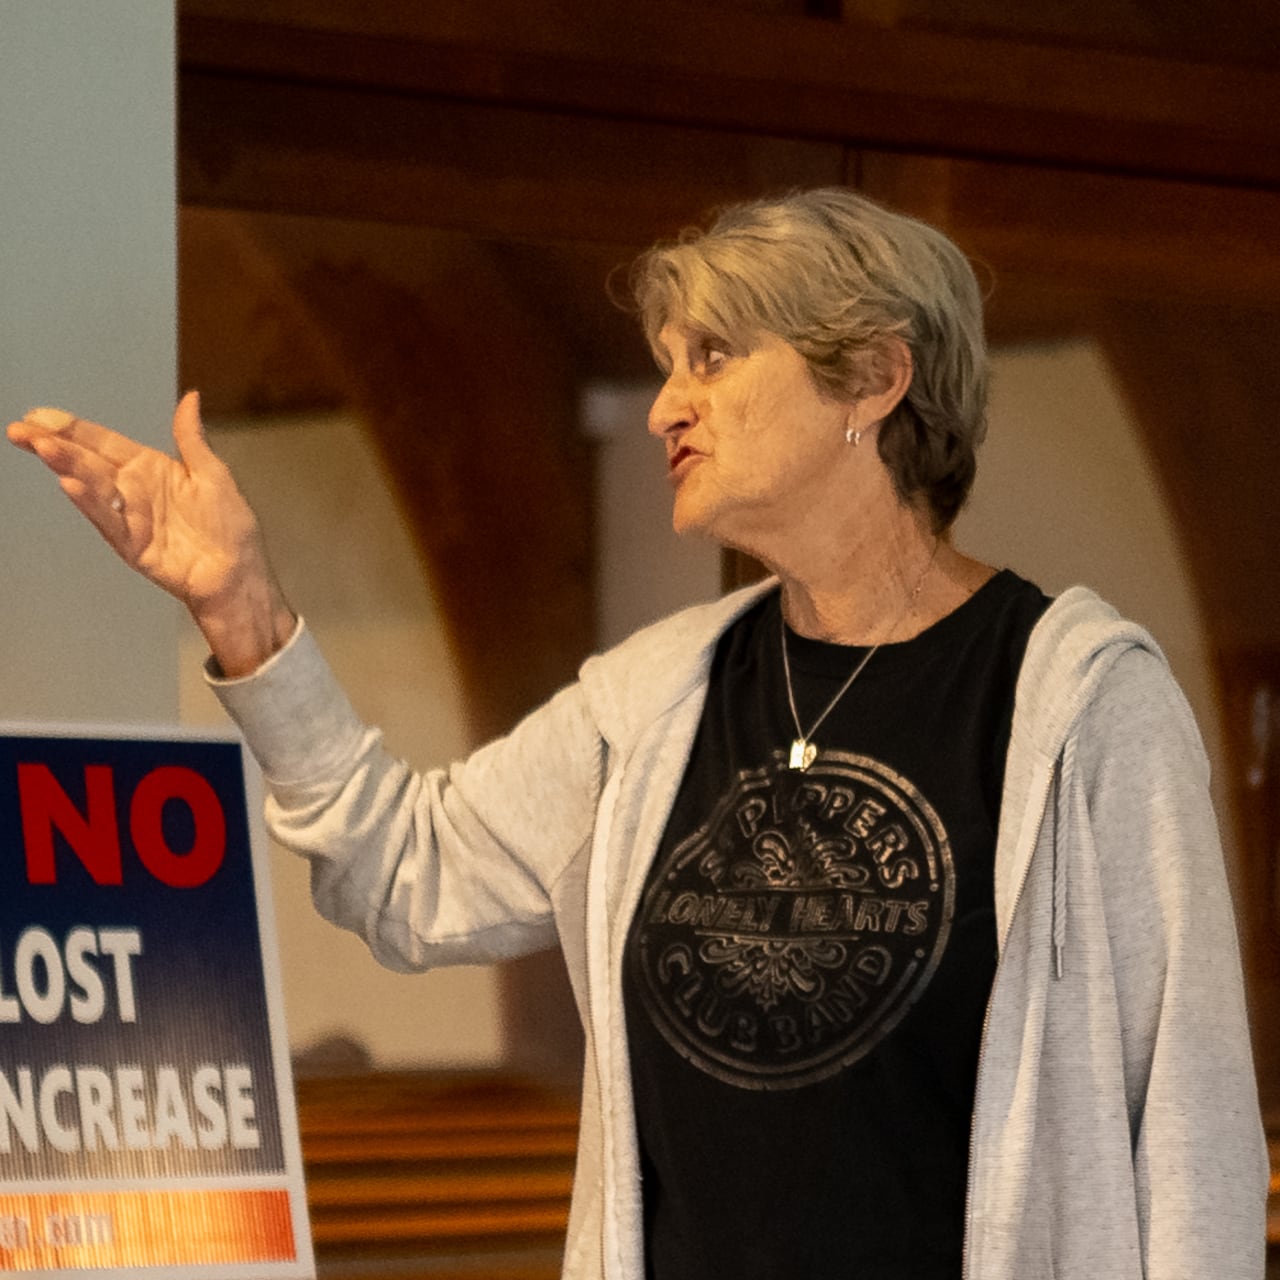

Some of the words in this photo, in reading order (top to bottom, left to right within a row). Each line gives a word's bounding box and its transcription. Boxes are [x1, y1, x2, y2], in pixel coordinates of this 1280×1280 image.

[17, 762, 227, 889] NO
[649, 892, 780, 931] LONELY
[789, 893, 930, 936] HEARTS
[658, 943, 758, 1051] CLUB
[769, 946, 893, 1052] BAND
